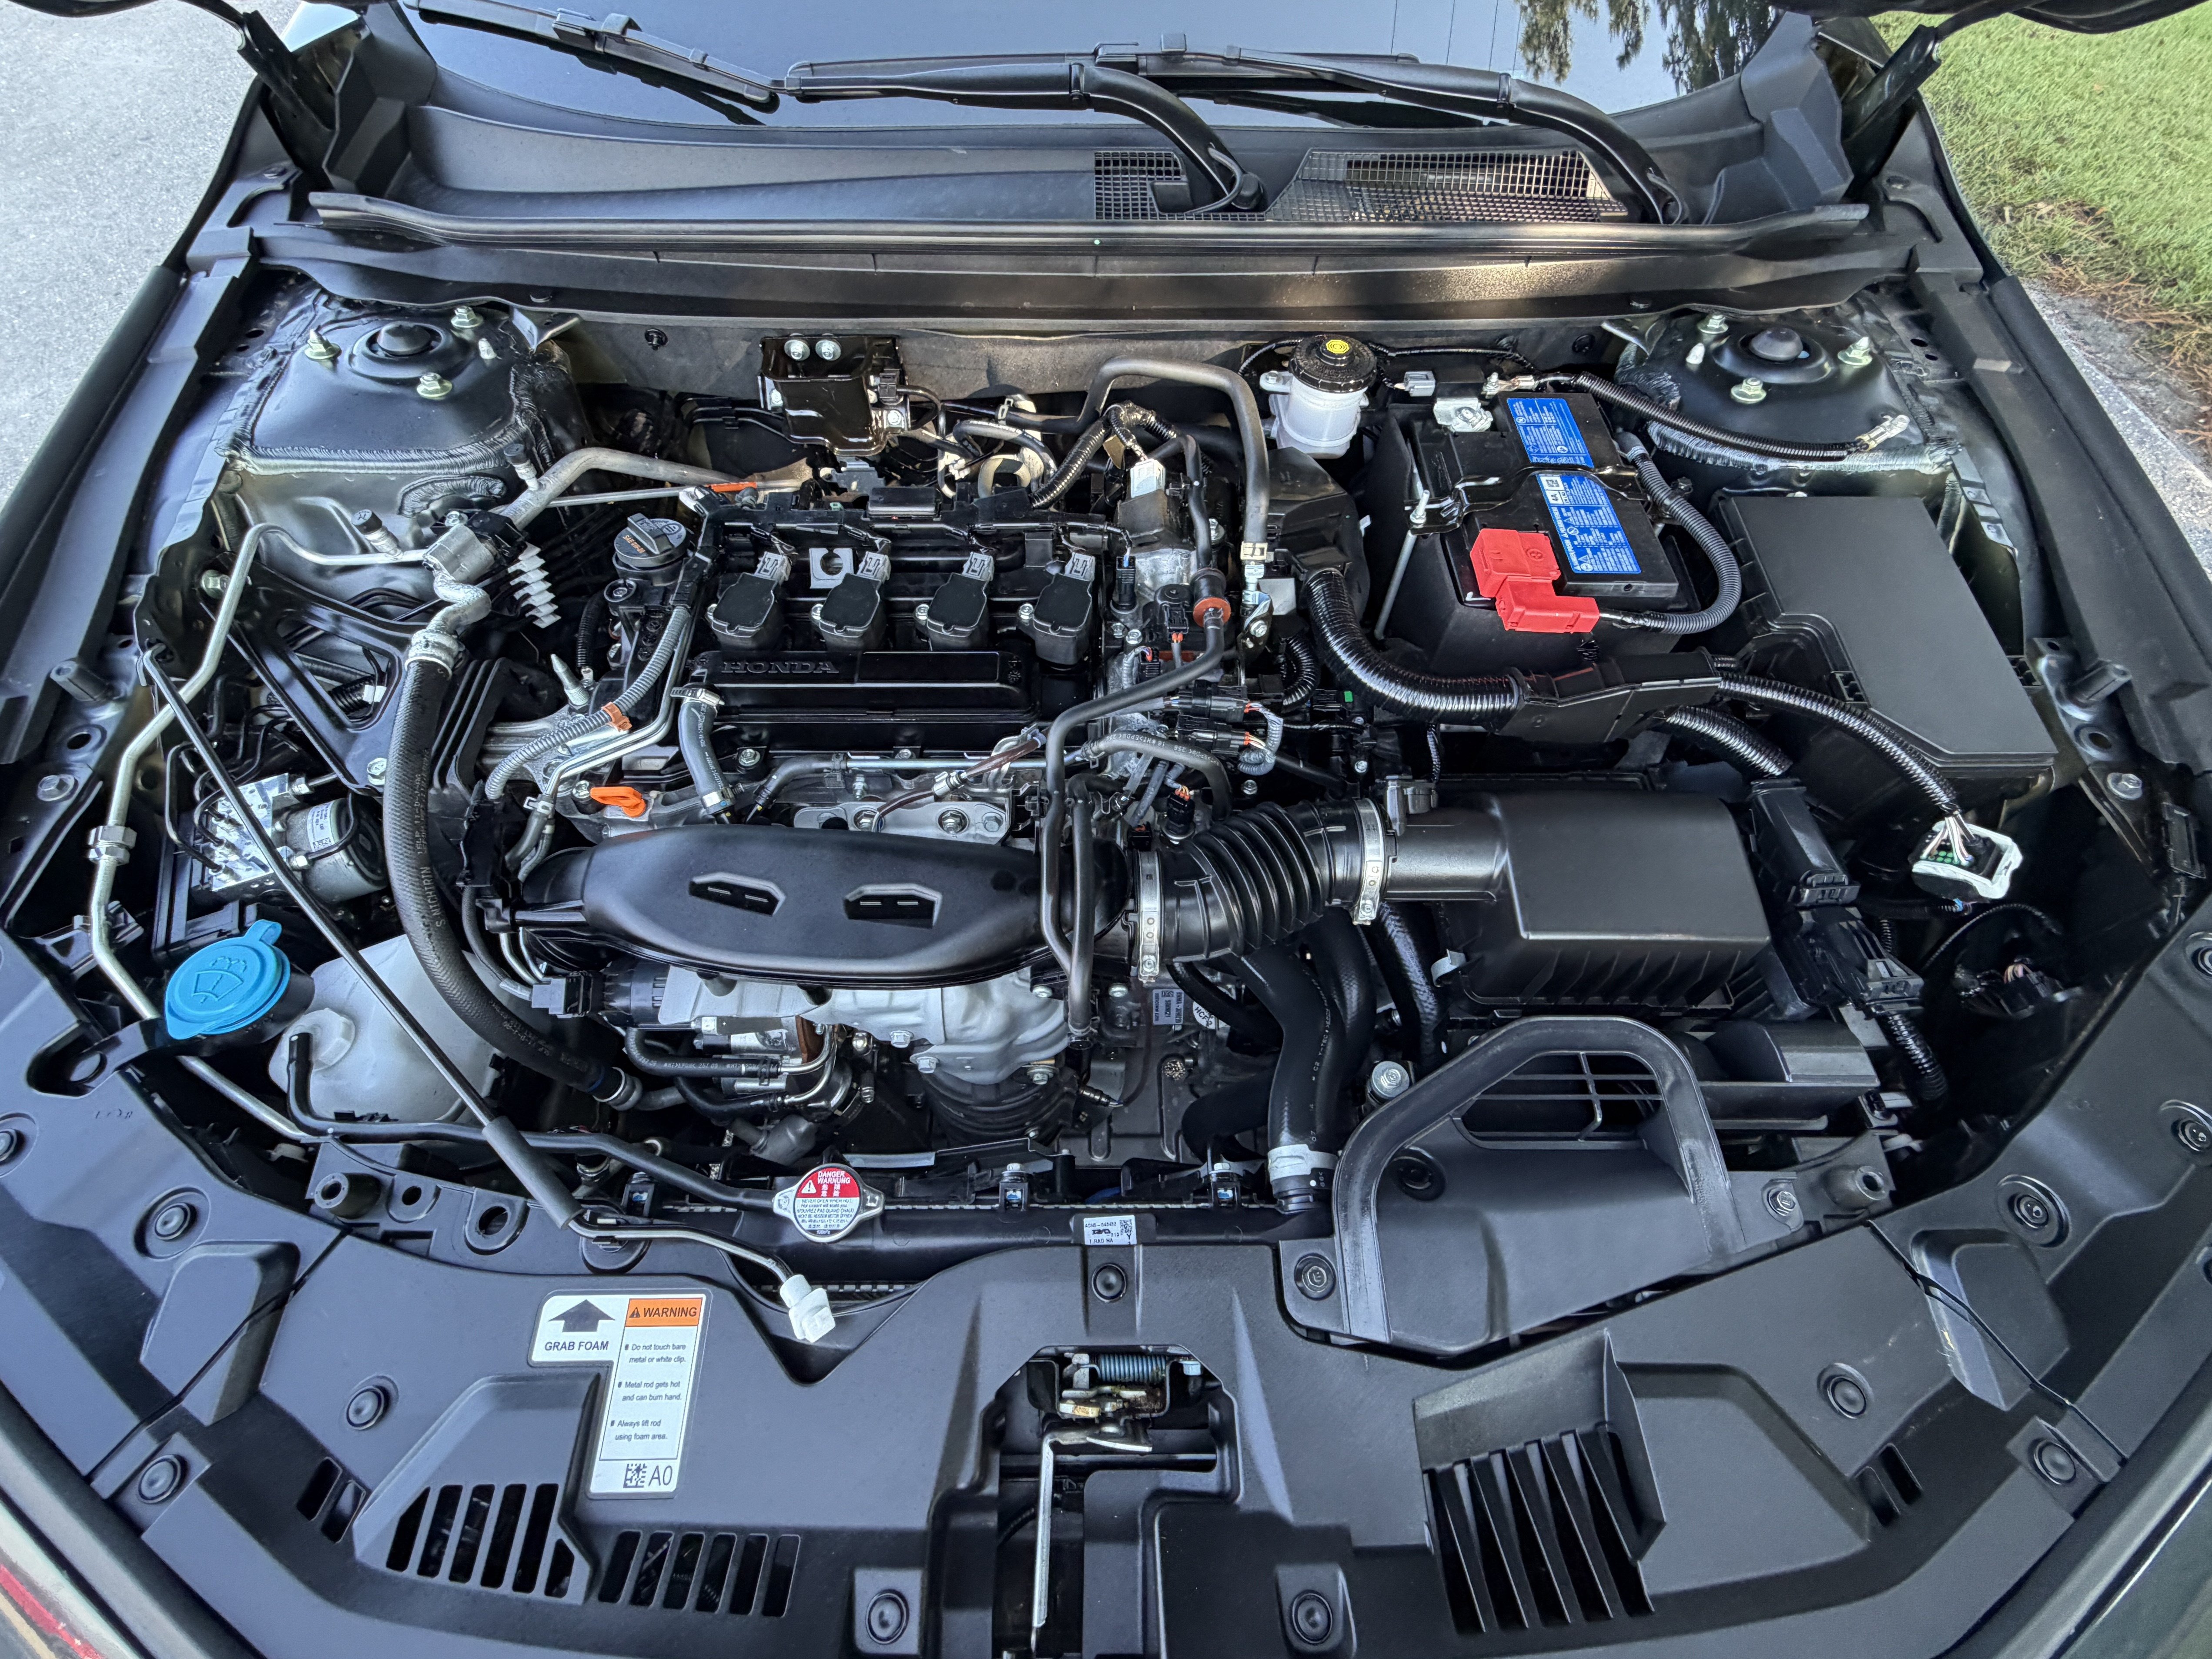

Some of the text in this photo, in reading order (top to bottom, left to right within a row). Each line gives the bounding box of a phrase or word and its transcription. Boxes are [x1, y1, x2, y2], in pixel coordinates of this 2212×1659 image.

[721, 661, 840, 674] HONDA
[420, 867, 441, 916] NICHIRIN
[643, 1307, 697, 1318] WARNING
[545, 1341, 609, 1351] GRAB FOAM
[648, 1465, 673, 1486] A0
